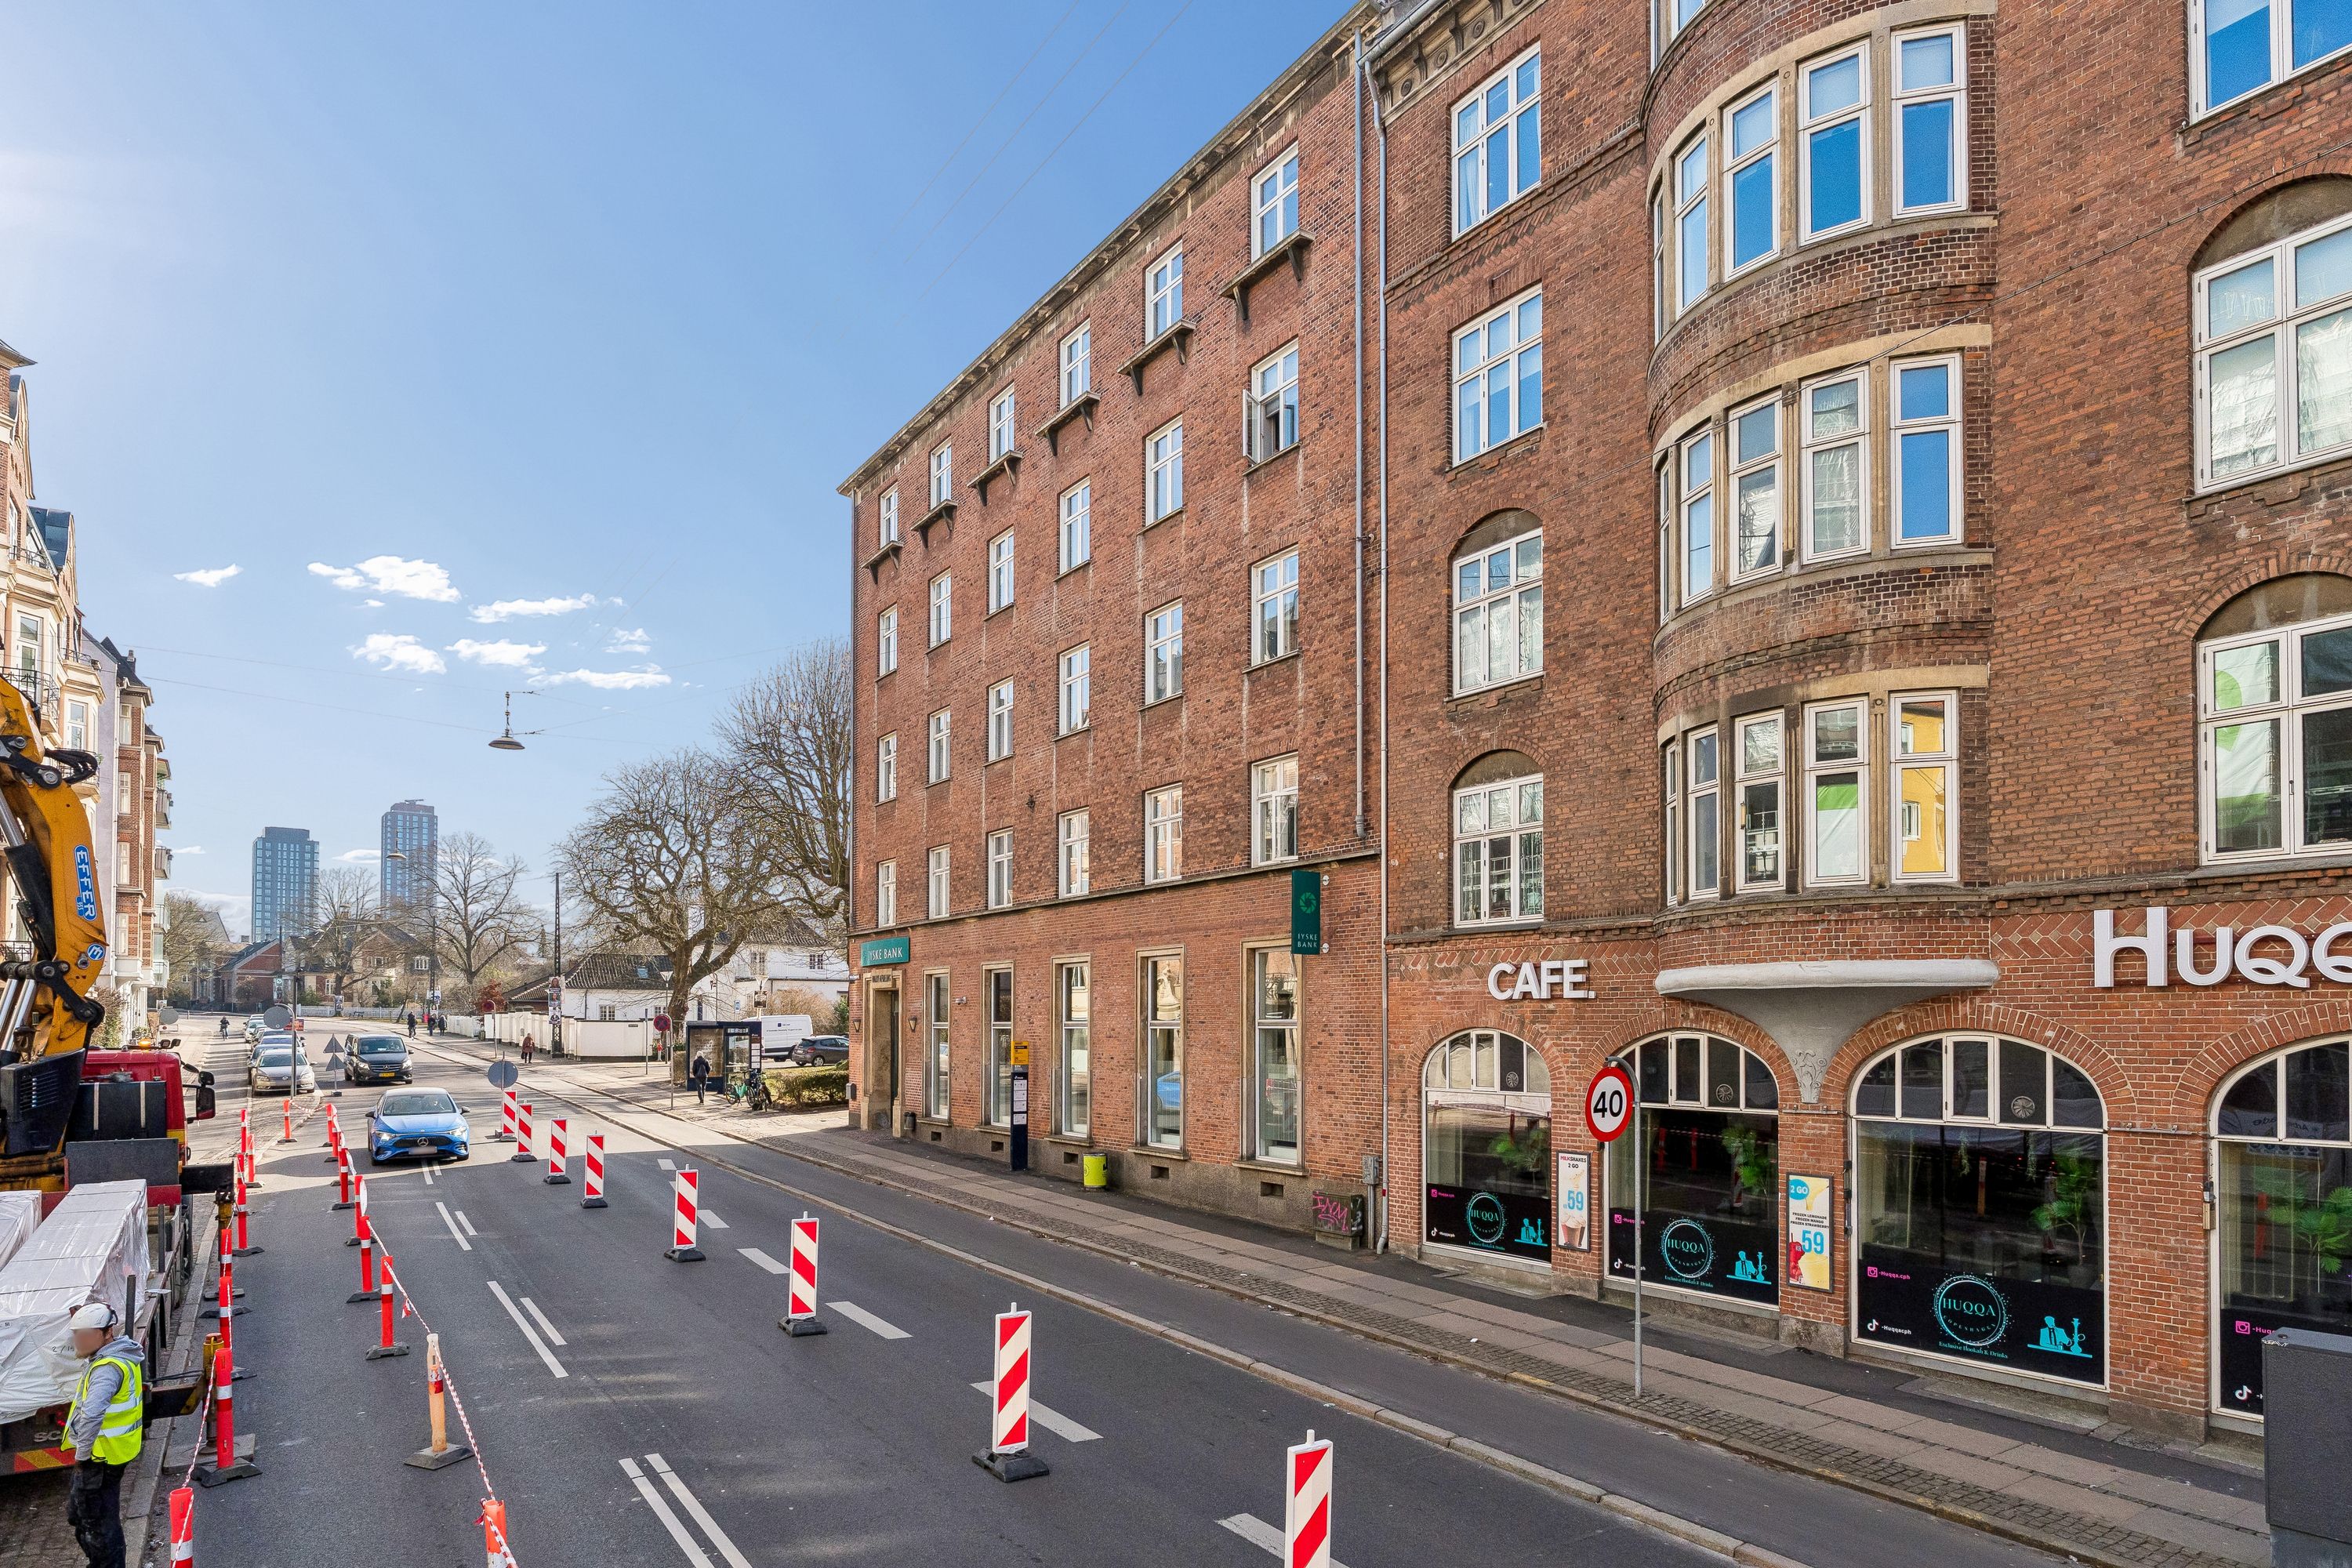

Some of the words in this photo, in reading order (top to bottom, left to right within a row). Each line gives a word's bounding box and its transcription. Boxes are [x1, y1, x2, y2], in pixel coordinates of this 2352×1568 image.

[76, 850, 95, 917] EFFER
[867, 949, 882, 961] JYSKE
[884, 946, 902, 958] BANK
[1593, 1090, 1623, 1118] 40
[1567, 1189, 1584, 1211] 59
[1471, 1209, 1499, 1221] HUQQA
[1667, 1239, 1704, 1253] HUQQA
[1802, 1229, 1824, 1254] 59
[1943, 1298, 1996, 1316] HUQQA
[1939, 1341, 1962, 1350] Exclusive
[1963, 1345, 1984, 1355] Hookah
